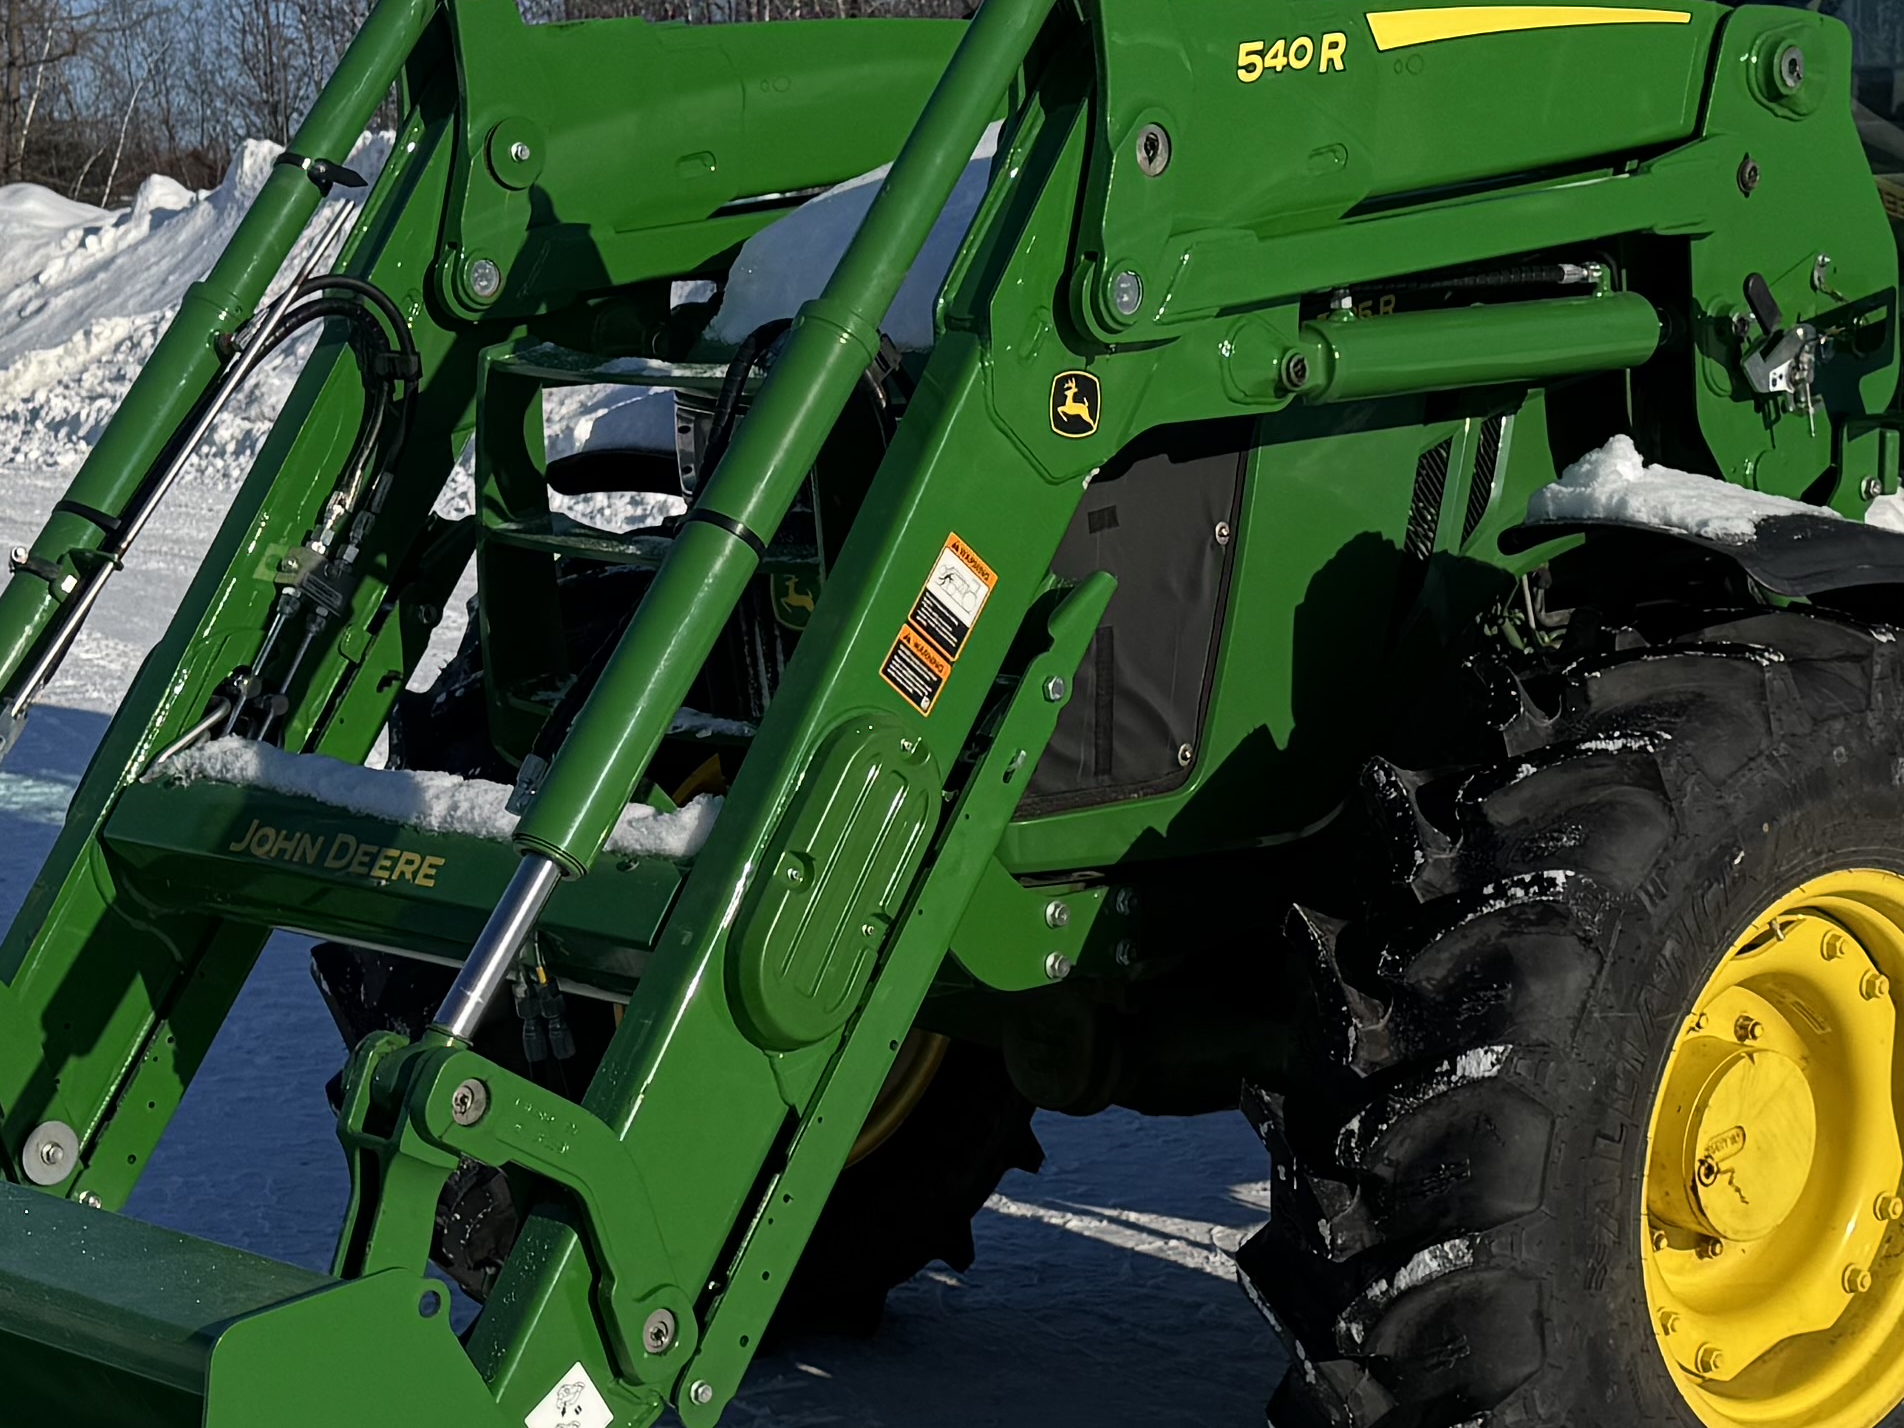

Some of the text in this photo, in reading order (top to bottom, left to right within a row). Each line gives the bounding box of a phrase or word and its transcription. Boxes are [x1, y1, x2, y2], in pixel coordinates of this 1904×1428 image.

[1237, 31, 1347, 83] 540 R
[229, 819, 445, 887] JOHN DEERE
